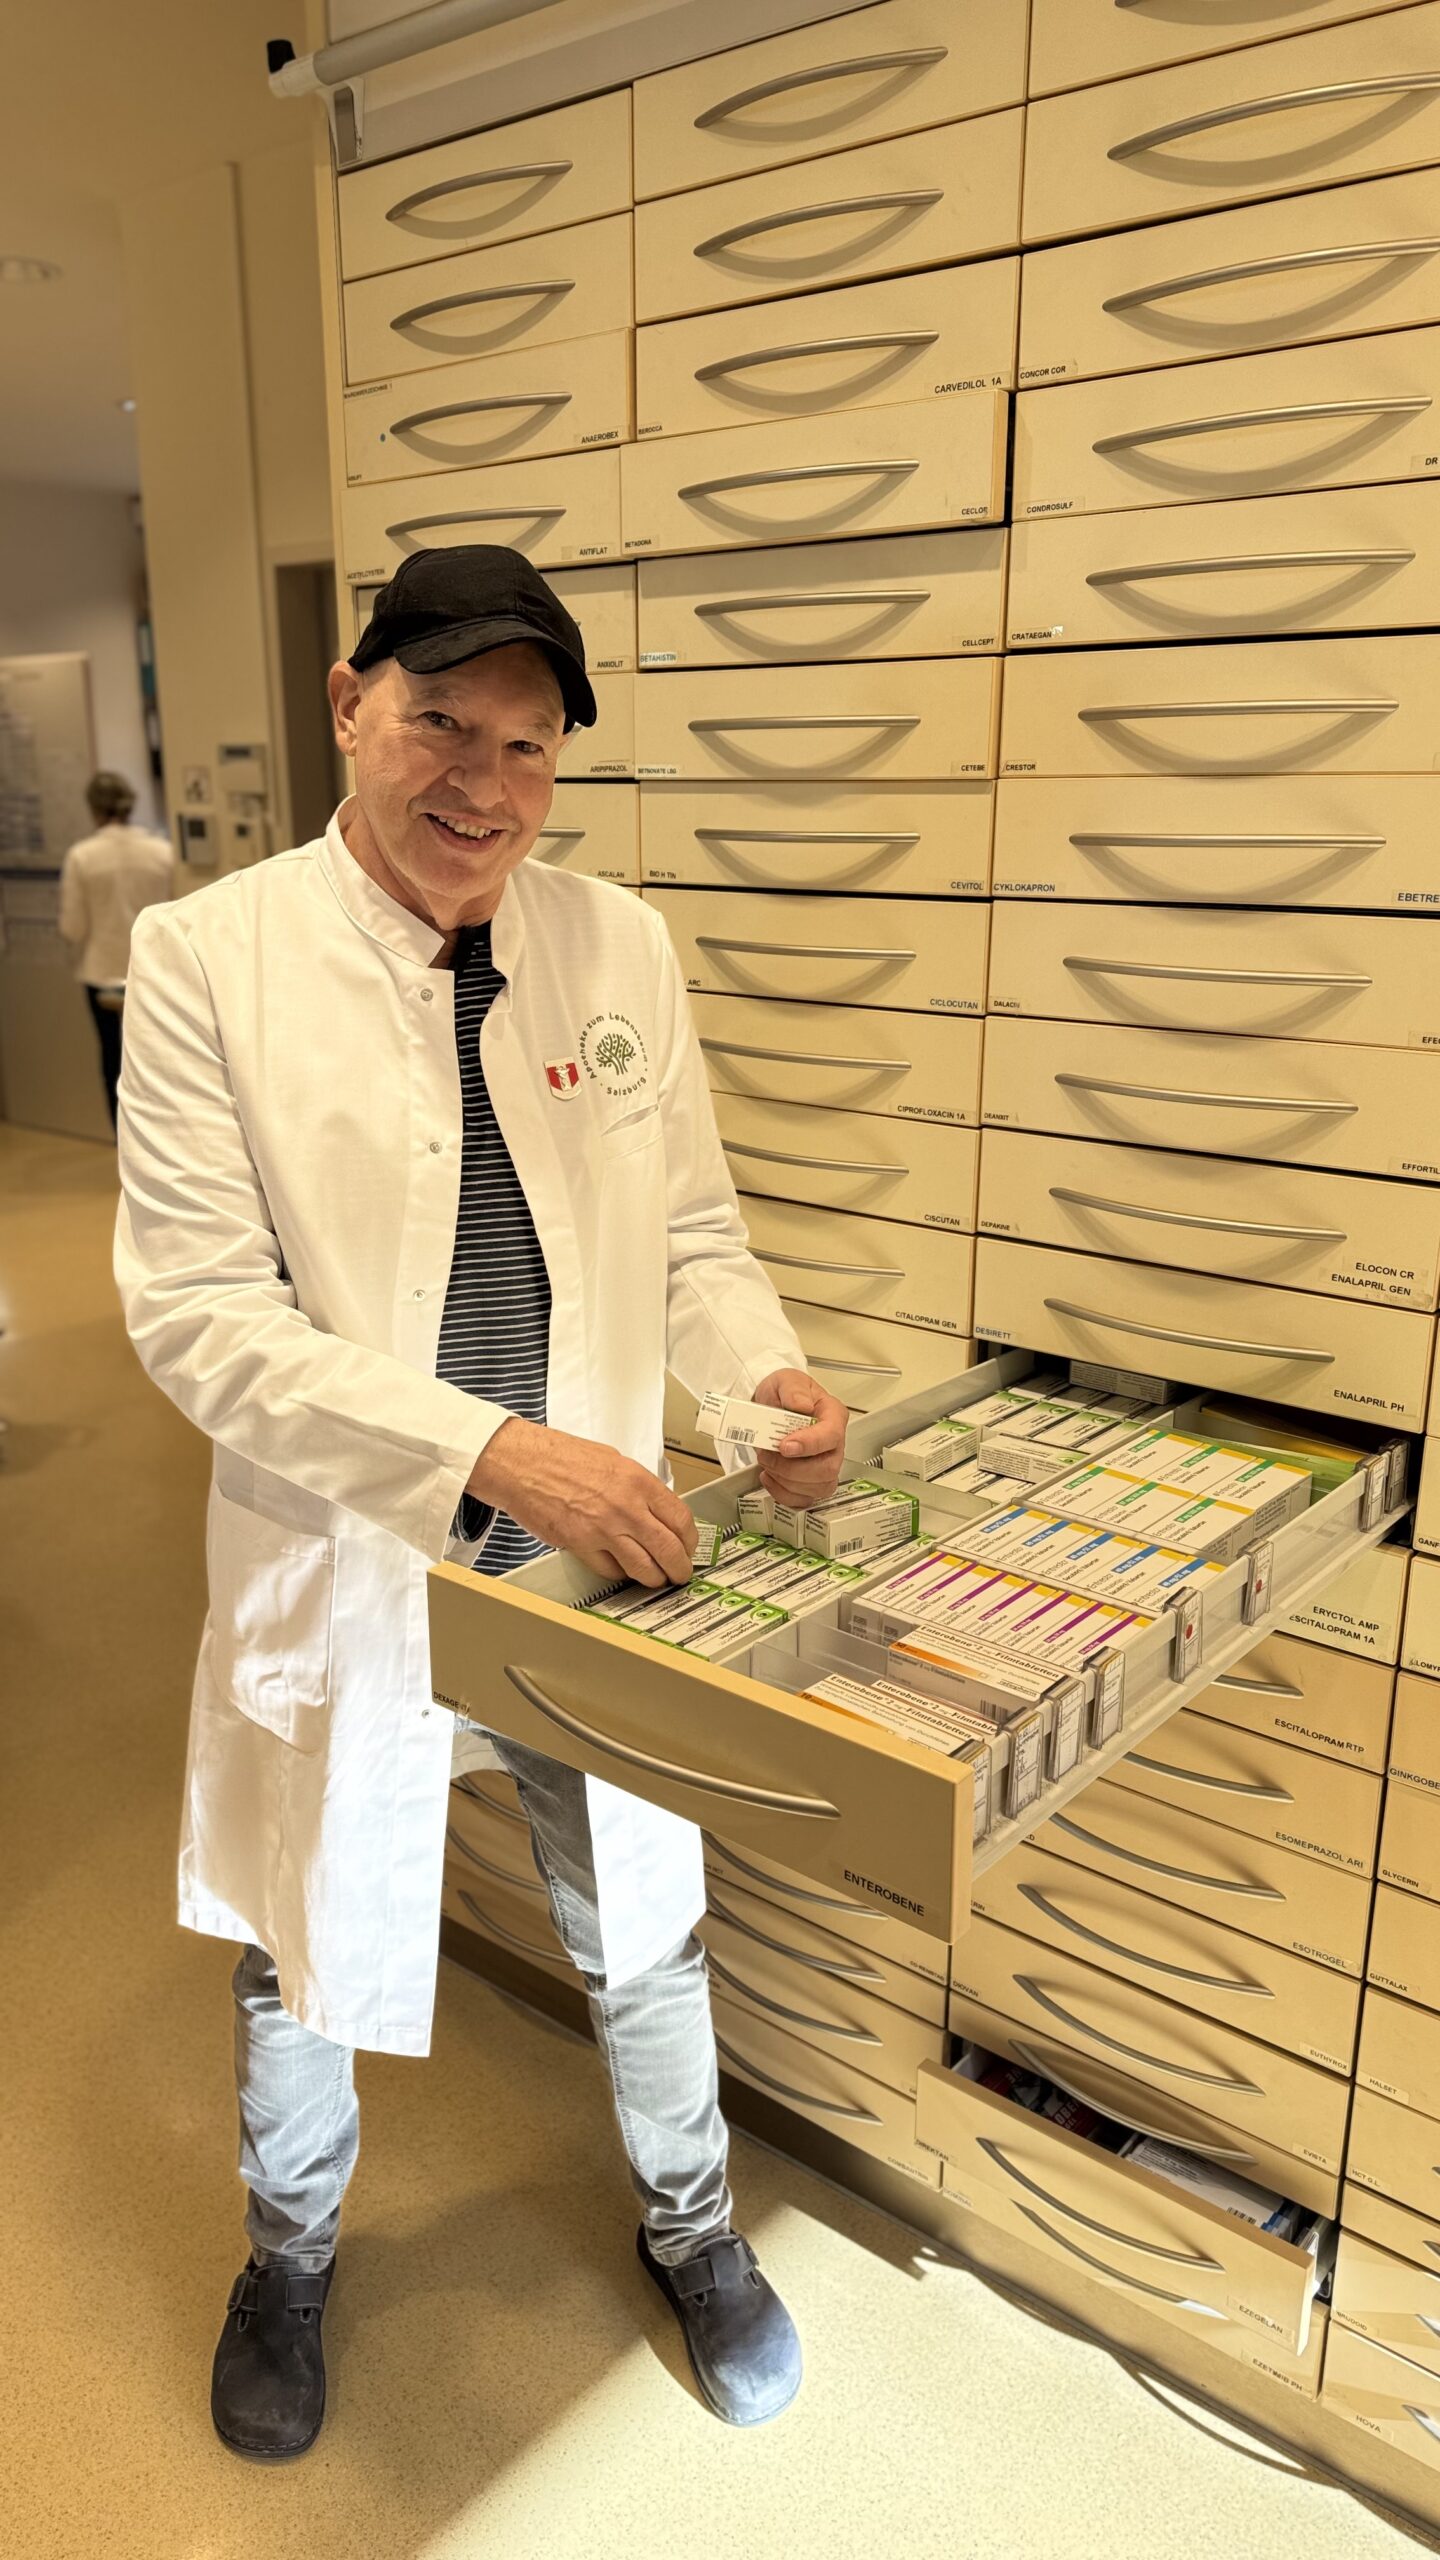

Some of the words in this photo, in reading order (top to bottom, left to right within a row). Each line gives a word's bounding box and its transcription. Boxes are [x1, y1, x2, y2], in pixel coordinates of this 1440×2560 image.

[1020, 368, 1049, 379] CONCOR
[1051, 366, 1066, 375] COR
[934, 380, 986, 394] CARVEDILOL
[991, 377, 1002, 386] 1A
[581, 431, 619, 444] ANAEROBEX
[1425, 457, 1438, 466] DR
[1027, 502, 1073, 513] CONDROSULF
[579, 547, 608, 556] ANTIFLAT
[962, 638, 994, 647] CELLCEPT
[597, 660, 623, 668] ANXIOLIT
[640, 654, 677, 662] BETAHISTIN
[590, 764, 628, 773] ARIPIPRAZOL
[961, 764, 985, 772] CETEBE
[1005, 763, 1036, 771] CRESTOR
[597, 870, 625, 879] ASCALAN
[950, 881, 984, 891] CEVITOL
[993, 883, 1056, 893] CYKLOKAPRON
[930, 998, 978, 1010] CICLOCUTAN
[606, 1076, 647, 1097] Salzburg
[897, 1105, 954, 1119] CIPROFLOXACIN
[956, 1112, 966, 1121] 1A
[924, 1214, 960, 1226] CISCUTAN
[981, 1220, 1010, 1231] DEPAKINE
[1355, 1262, 1397, 1277] ELOCON
[1399, 1270, 1414, 1280] CR
[1331, 1273, 1386, 1291] ENALAPRIL
[1389, 1285, 1411, 1296] GEN
[895, 1311, 940, 1327] CITALOPRAM
[942, 1320, 957, 1329] GEN
[975, 1327, 1011, 1340] DESIRETT
[1334, 1389, 1387, 1409] ENALAPRIL
[1390, 1402, 1404, 1412] PH
[1313, 1606, 1355, 1625] ERYCTOL
[1358, 1619, 1380, 1631] AMP
[1289, 1614, 1361, 1640] ESCITALOPRAM
[1363, 1635, 1376, 1645] 1A
[1274, 1718, 1344, 1749] ESCITALOPRAM
[1346, 1742, 1365, 1754] RTP
[1275, 1831, 1344, 1862] ESOMEPRAZOL
[1346, 1857, 1364, 1869] ARI
[1382, 1869, 1419, 1888] GLYCERIN
[844, 1869, 925, 1917] ENTEROBENE
[1292, 1941, 1346, 1968] ESOTROGEL
[953, 1980, 978, 1997] DIOVAN
[1369, 1972, 1408, 1992] GUTTALAX
[1310, 2049, 1348, 2071] EUTHYROX
[1369, 2078, 1397, 2095] HALSET
[1303, 2149, 1327, 2164] EVISTA
[1352, 2169, 1366, 2179] HCT
[1239, 2305, 1284, 2334] EZEGELAN
[1356, 2415, 1381, 2433] HOVA
